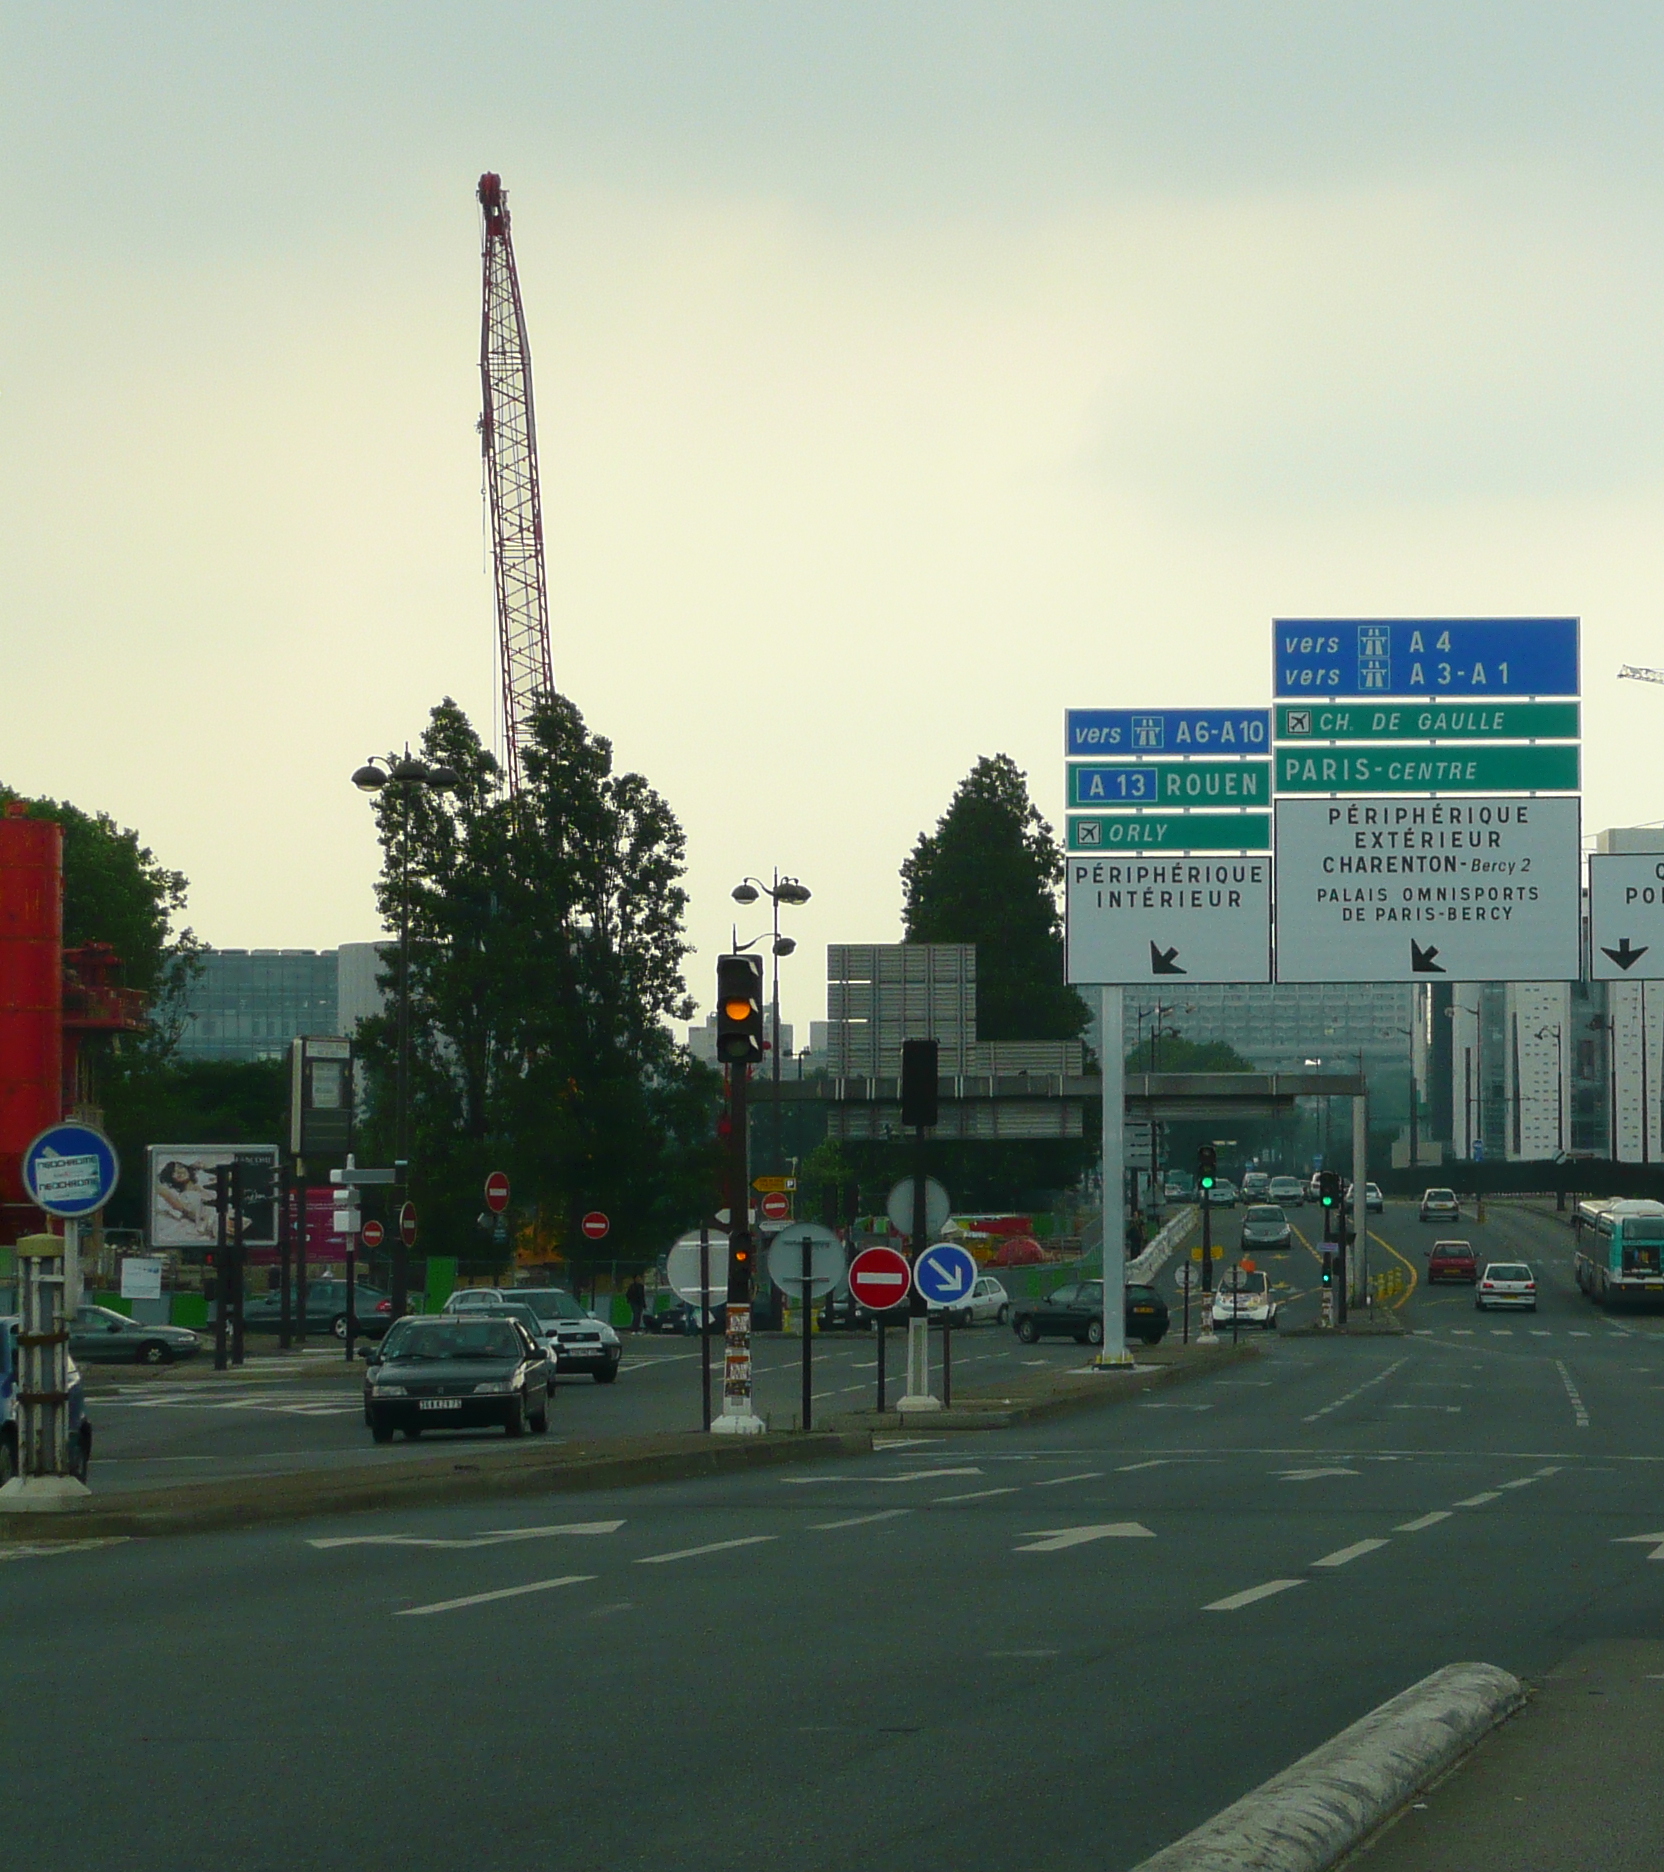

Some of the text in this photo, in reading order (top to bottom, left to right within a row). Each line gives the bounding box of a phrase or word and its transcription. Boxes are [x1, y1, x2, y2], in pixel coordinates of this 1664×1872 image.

[1286, 631, 1450, 653] vers A 4
[1286, 669, 1339, 685] vers
[1411, 663, 1424, 684] A
[1499, 662, 1507, 683] 1
[1372, 713, 1400, 730] DE
[1419, 712, 1504, 730] GAULLE
[1076, 728, 1120, 743] vers
[1090, 773, 1256, 796] A 13 ROUEN
[1329, 804, 1528, 825] PÉRIPHÉRIQUE
[1110, 824, 1167, 841] ORLY
[1356, 827, 1500, 848] EXTÉRIEUR
[1076, 862, 1262, 884] PÉRIPHÉRIQUE
[1521, 858, 1530, 872] 2
[1098, 887, 1240, 908] INTÉRIEUR
[1318, 887, 1538, 902] PALAIS OMNISPORTS
[1343, 906, 1512, 921] DE PARIS-BERCY
